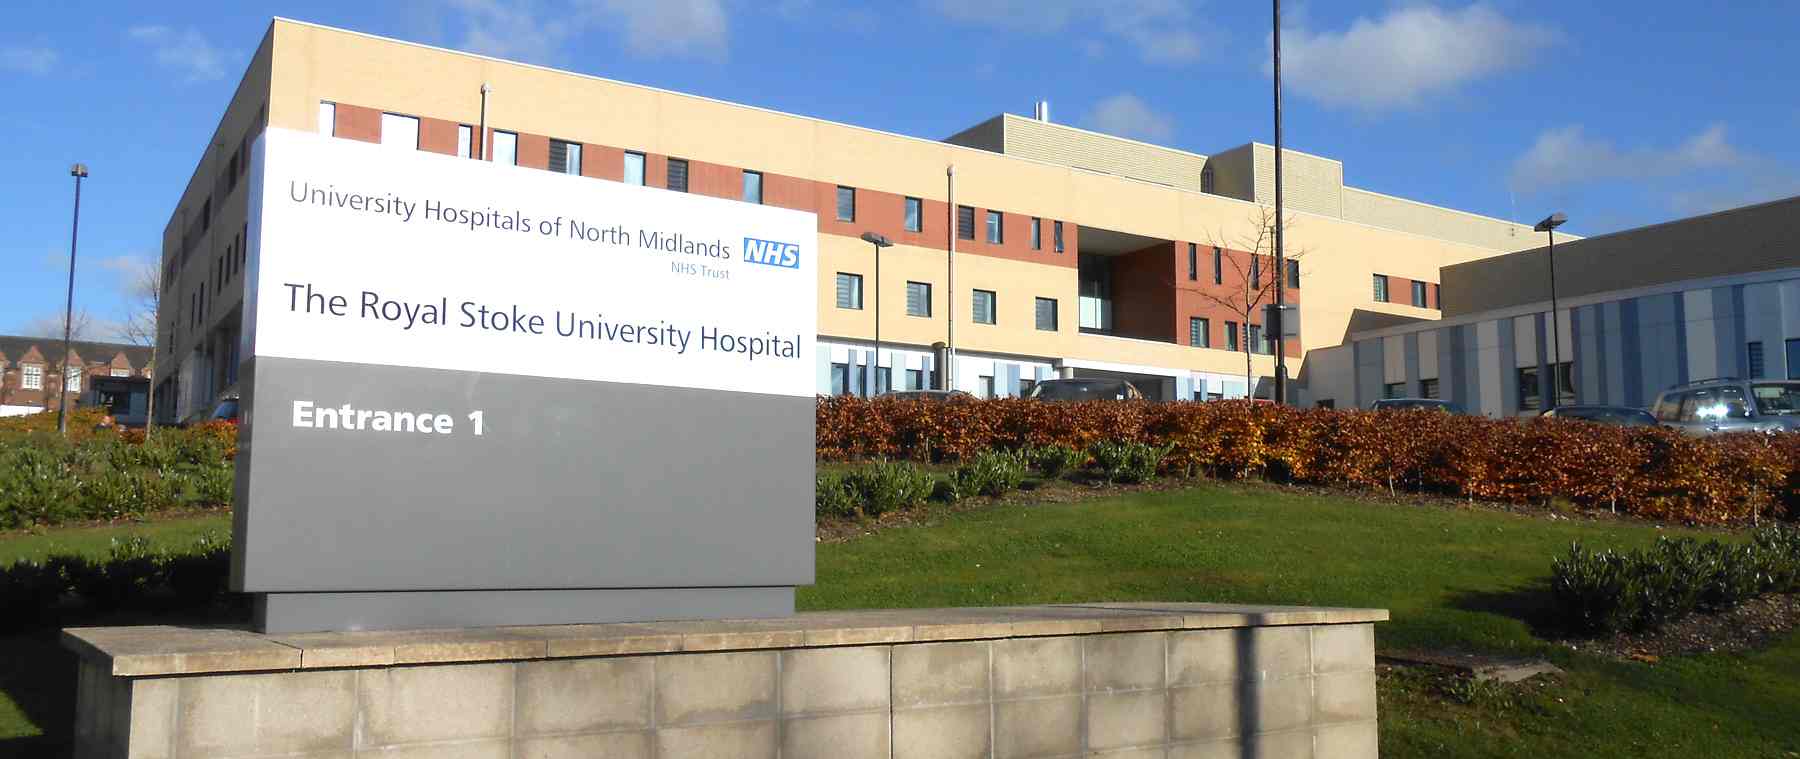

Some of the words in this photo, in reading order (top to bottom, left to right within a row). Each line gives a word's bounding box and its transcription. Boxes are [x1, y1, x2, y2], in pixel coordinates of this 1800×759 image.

[290, 180, 416, 222] University
[424, 200, 531, 232] Hospitals
[539, 217, 563, 237] of
[570, 219, 630, 246] North
[639, 229, 730, 259] Midlands
[671, 261, 697, 276] NHS
[701, 264, 730, 279] Trust
[744, 238, 799, 268] NHS
[284, 283, 347, 316] The
[360, 290, 447, 330] Royal
[459, 301, 545, 334] Stoke
[556, 311, 691, 354] University
[700, 326, 801, 361] Hospital
[292, 400, 454, 434] Entrance
[468, 410, 484, 436] 1
